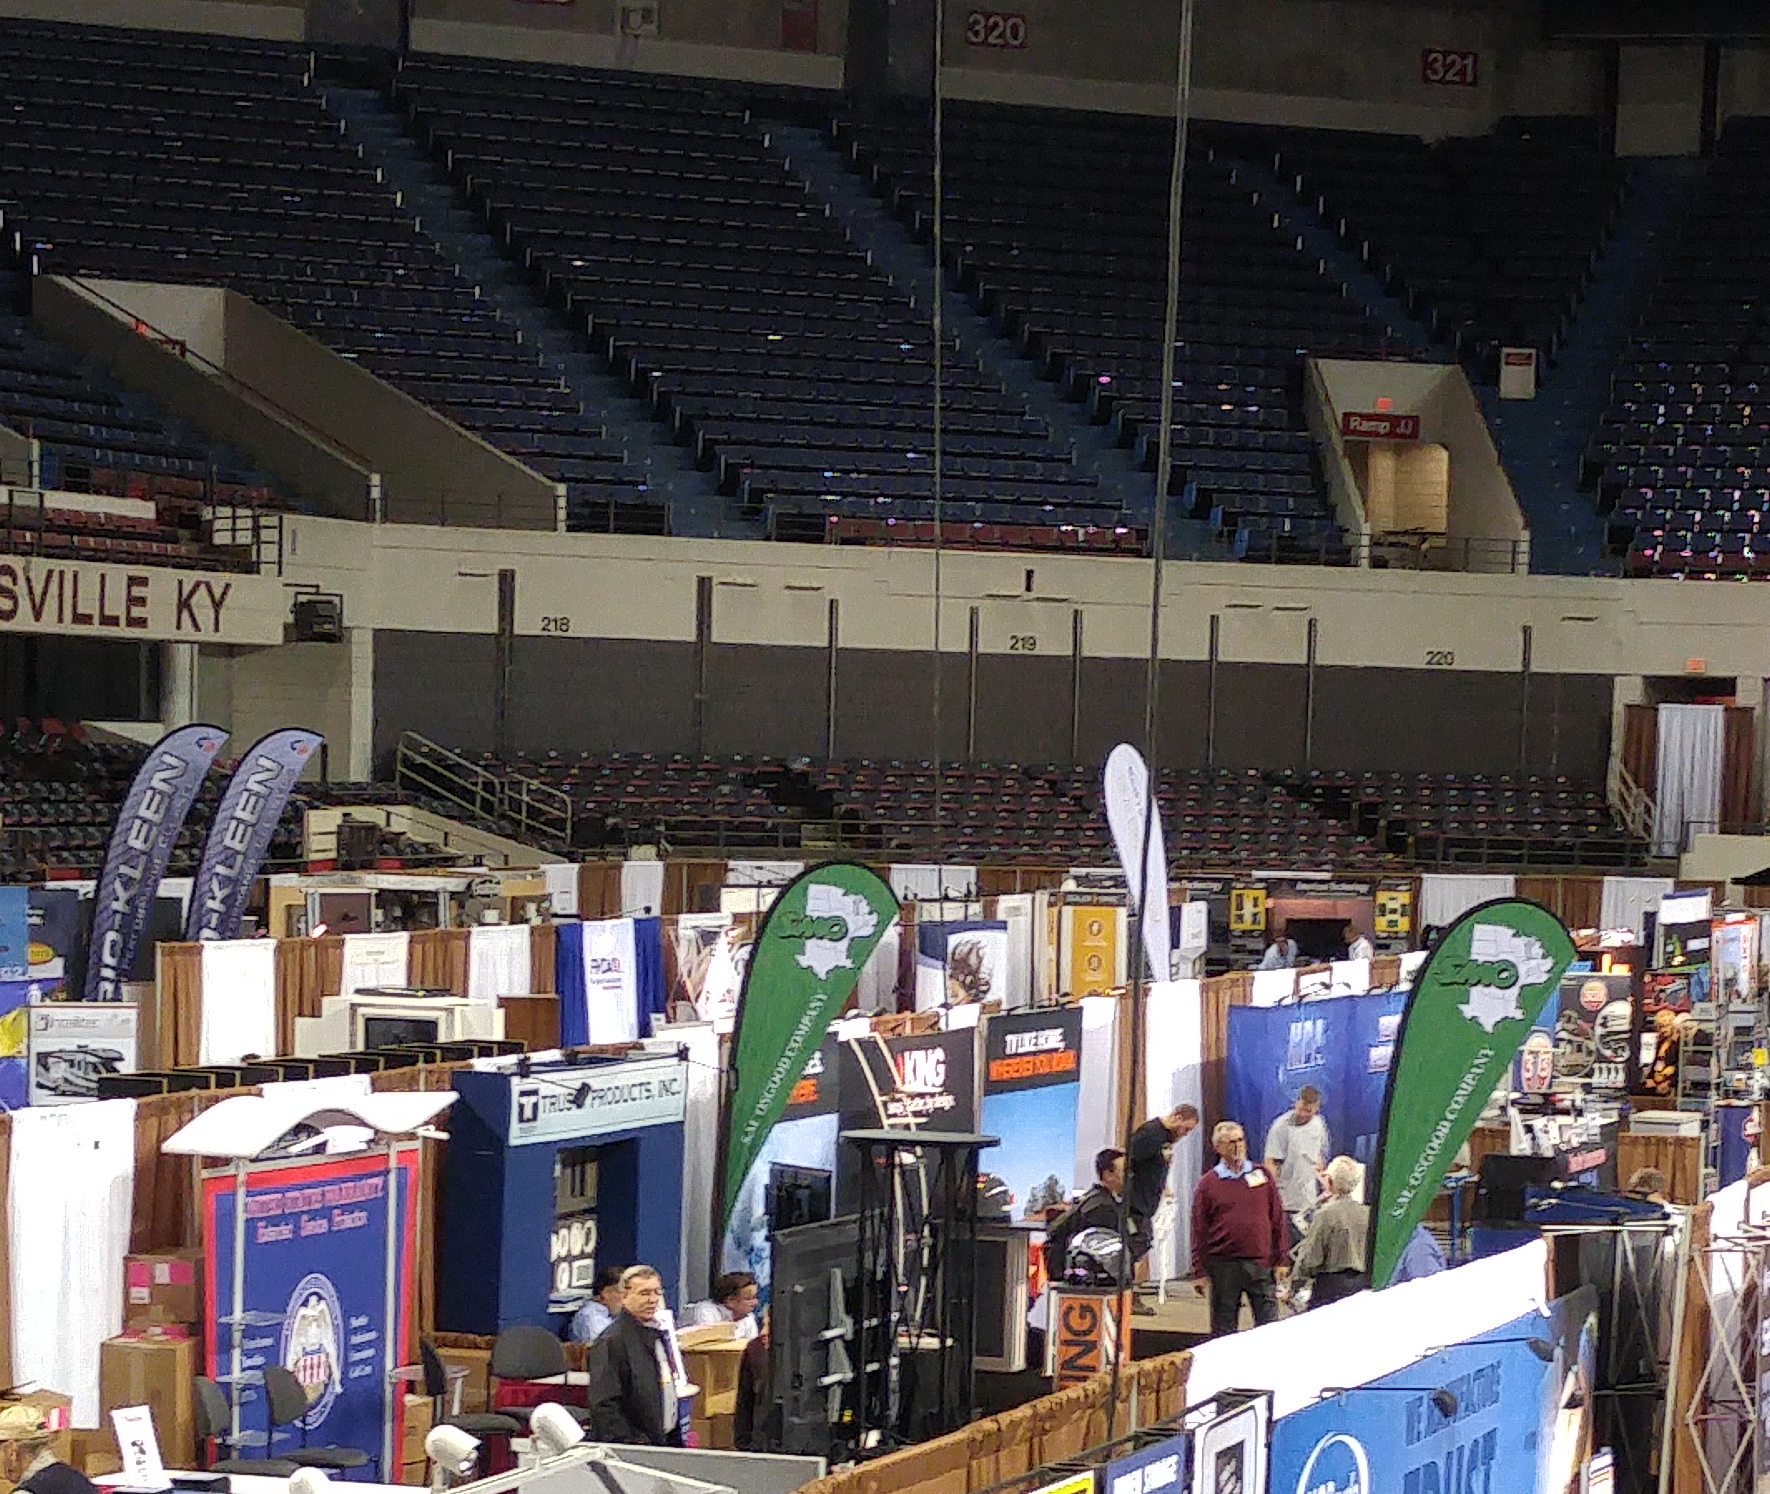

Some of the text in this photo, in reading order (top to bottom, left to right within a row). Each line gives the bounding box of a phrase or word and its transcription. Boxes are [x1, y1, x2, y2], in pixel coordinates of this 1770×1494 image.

[968, 13, 1025, 46] 320
[1427, 51, 1473, 82] 321
[1349, 417, 1390, 434] Ramp
[175, 577, 232, 635] KY
[542, 616, 570, 632] 218
[1010, 635, 1036, 650] 219
[1426, 651, 1454, 665] 220
